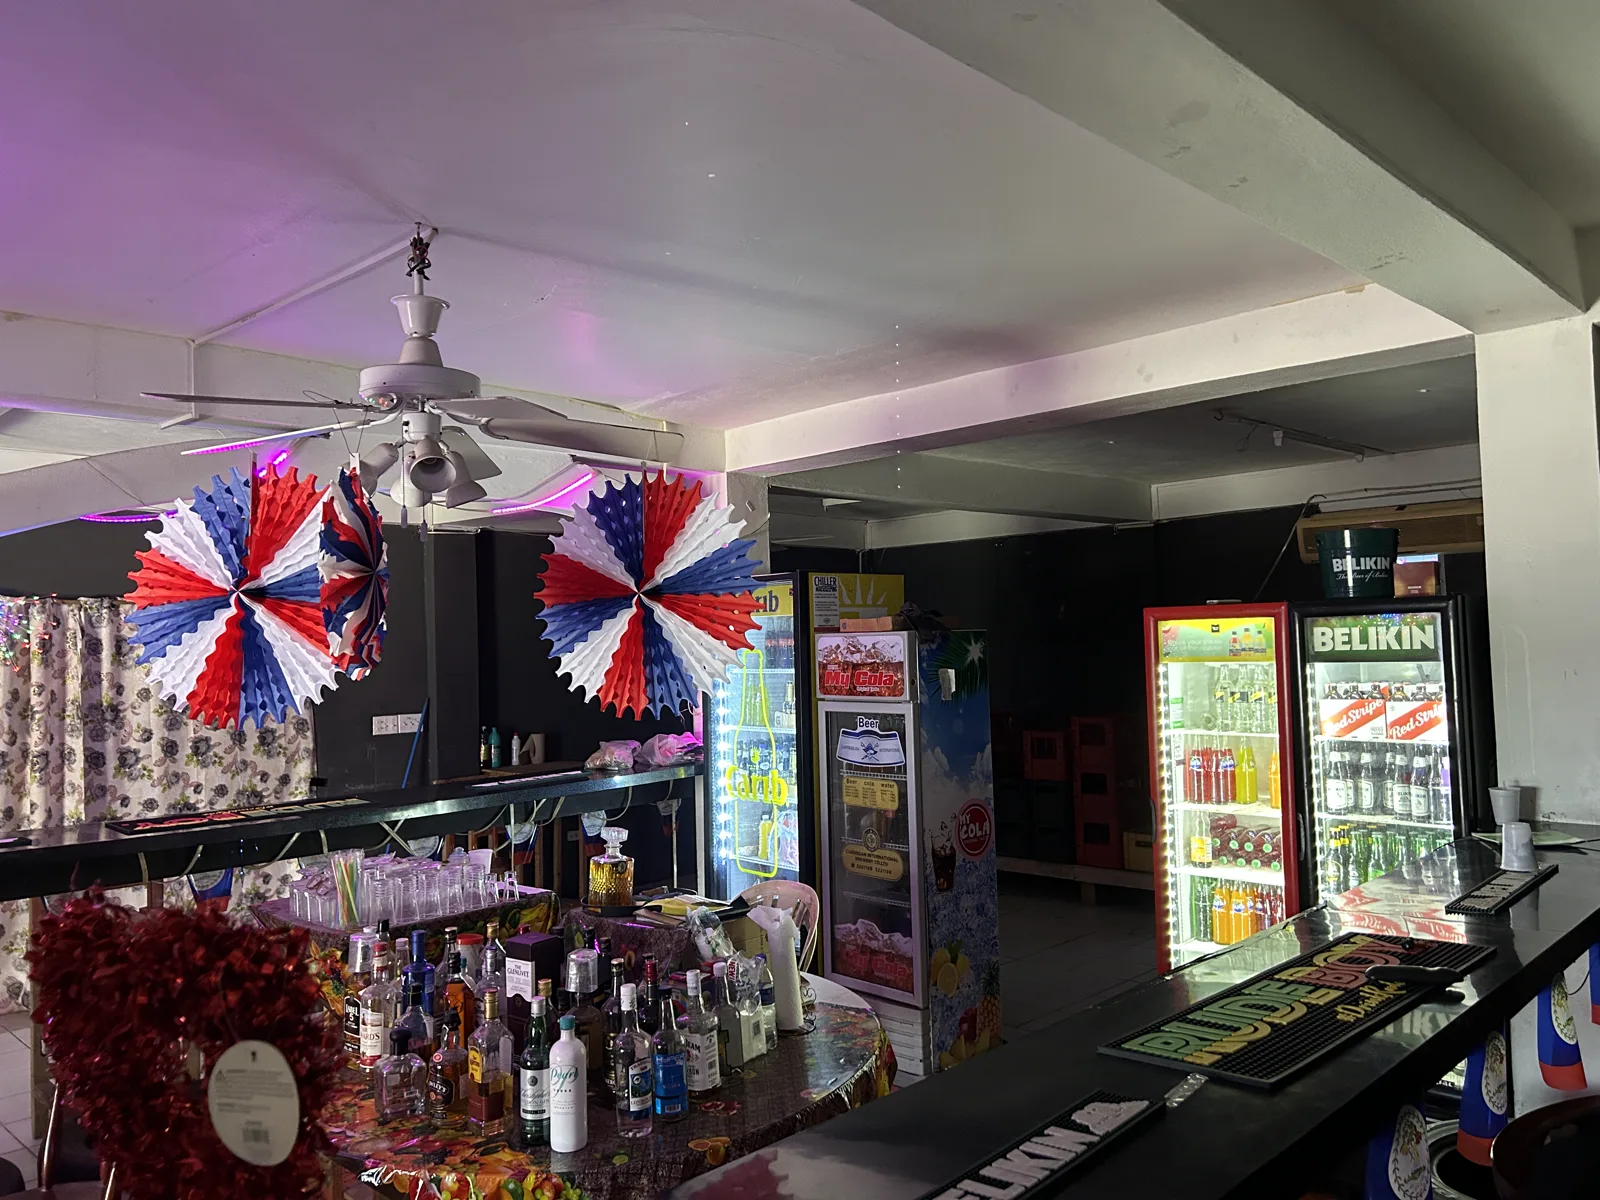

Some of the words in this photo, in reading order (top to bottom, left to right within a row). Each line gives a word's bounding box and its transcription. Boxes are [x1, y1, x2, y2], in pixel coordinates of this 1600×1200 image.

[814, 576, 837, 587] CHILLER
[750, 590, 779, 613] rib
[1313, 624, 1435, 652] BELIKIN
[825, 671, 850, 688] My
[854, 670, 894, 686] Cola
[1348, 699, 1383, 724] Stripe
[858, 717, 879, 728] Beer
[1390, 719, 1416, 740] Red
[726, 765, 788, 806] Carib
[960, 814, 971, 825] MY
[960, 821, 990, 839] COLA
[867, 853, 899, 862] INTERNATIONAL
[507, 968, 530, 978] GLENLIVET
[1120, 978, 1346, 1067] RUDE
[932, 1126, 1101, 1200] ELIKIN
